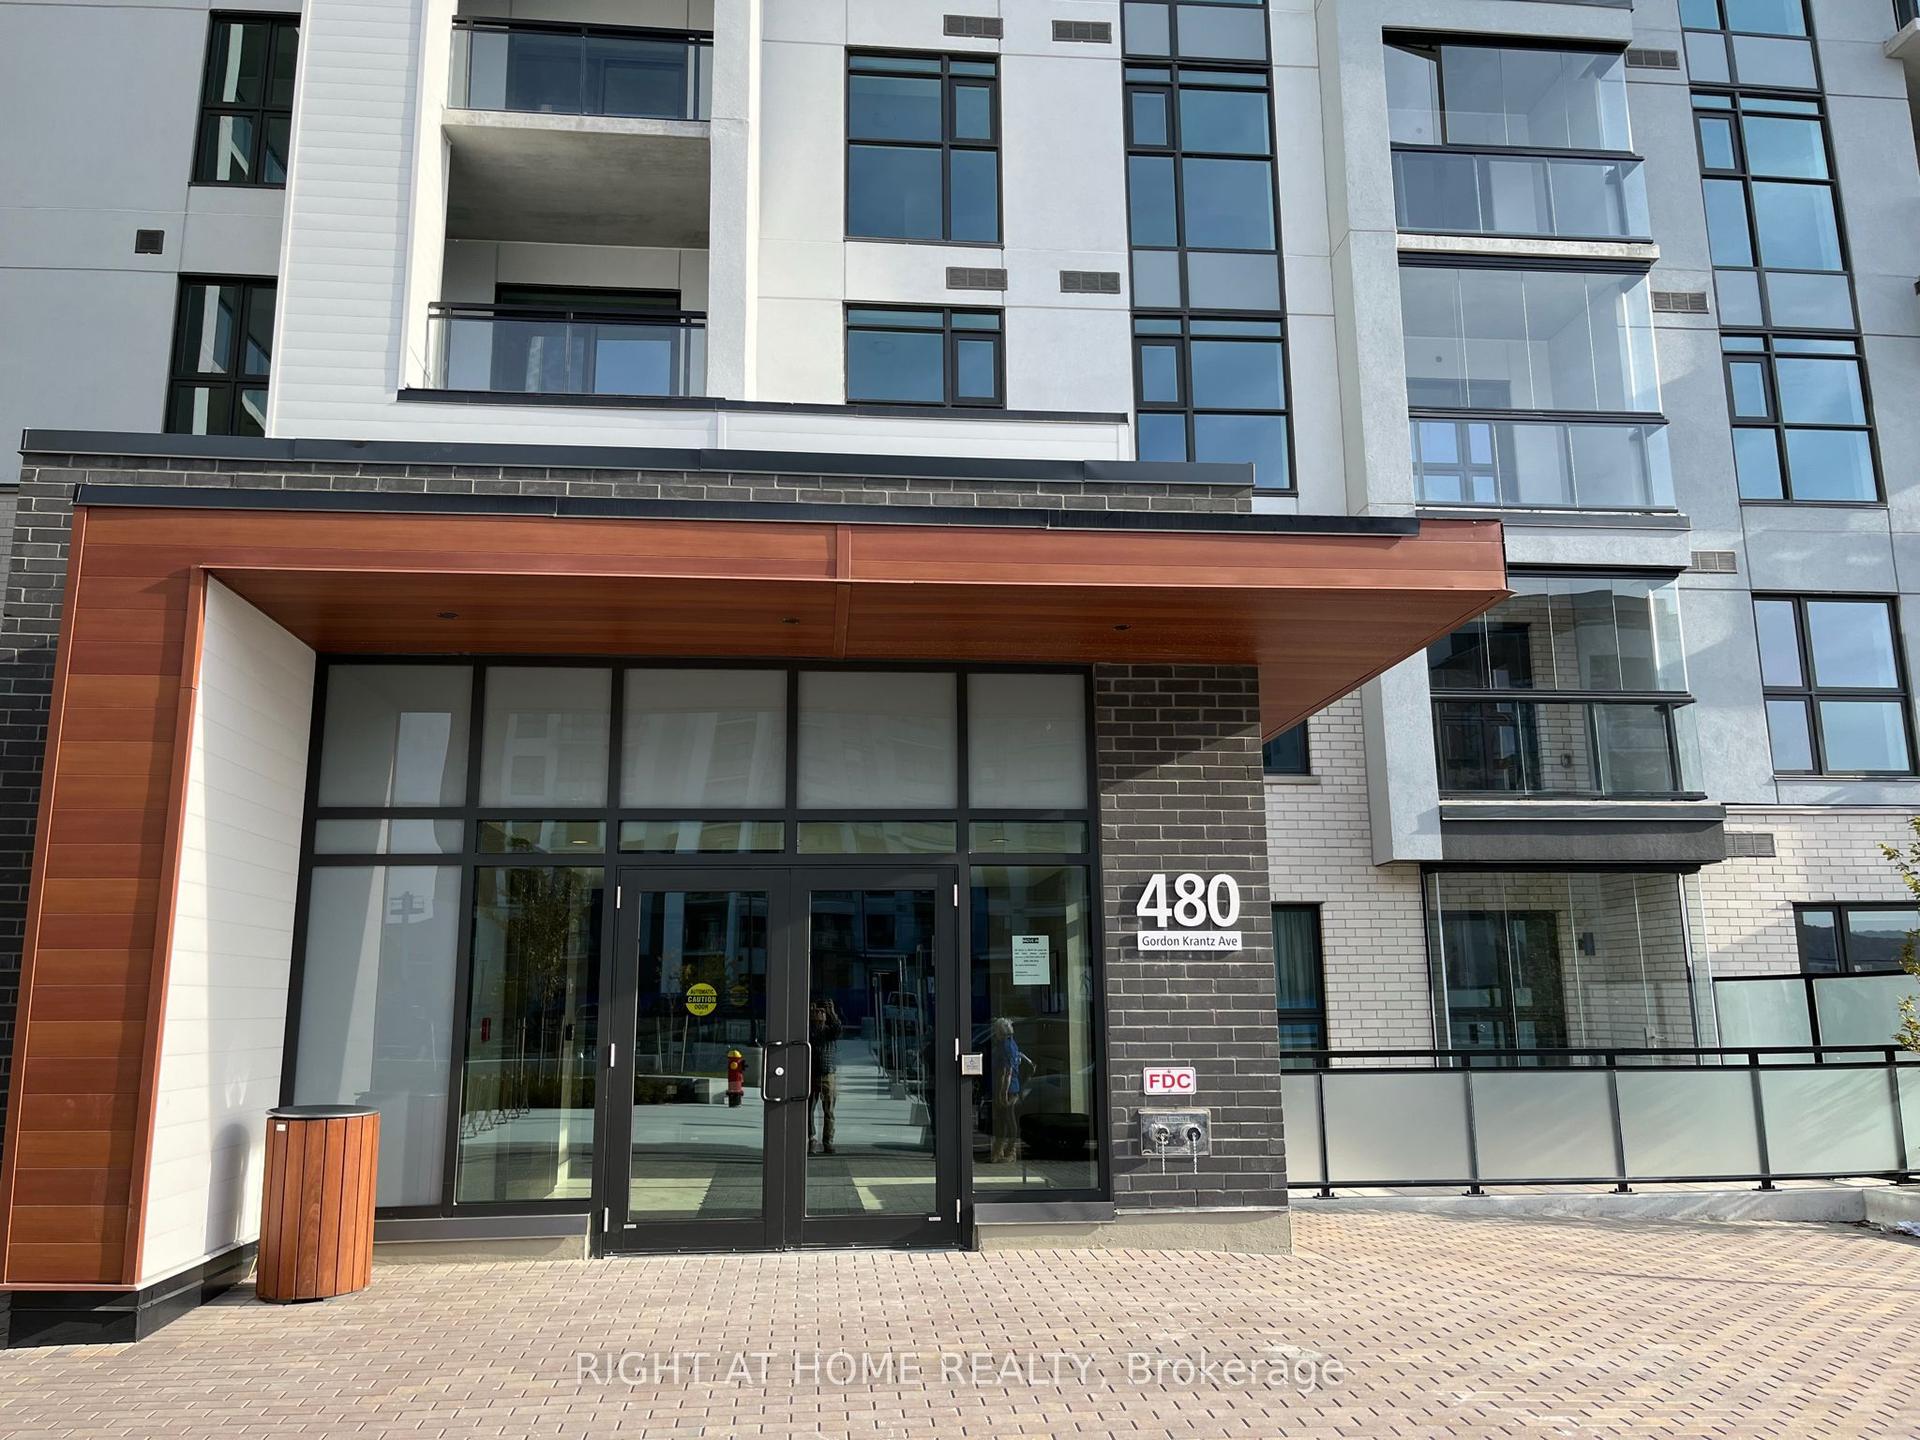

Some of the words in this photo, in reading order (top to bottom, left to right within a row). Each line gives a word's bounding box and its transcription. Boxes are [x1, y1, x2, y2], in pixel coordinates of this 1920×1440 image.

[1136, 873, 1240, 928] 480
[1142, 935, 1180, 946] Gordon
[1182, 935, 1216, 946] Krantz
[1218, 936, 1238, 946] Ave
[1149, 1074, 1191, 1089] FDC
